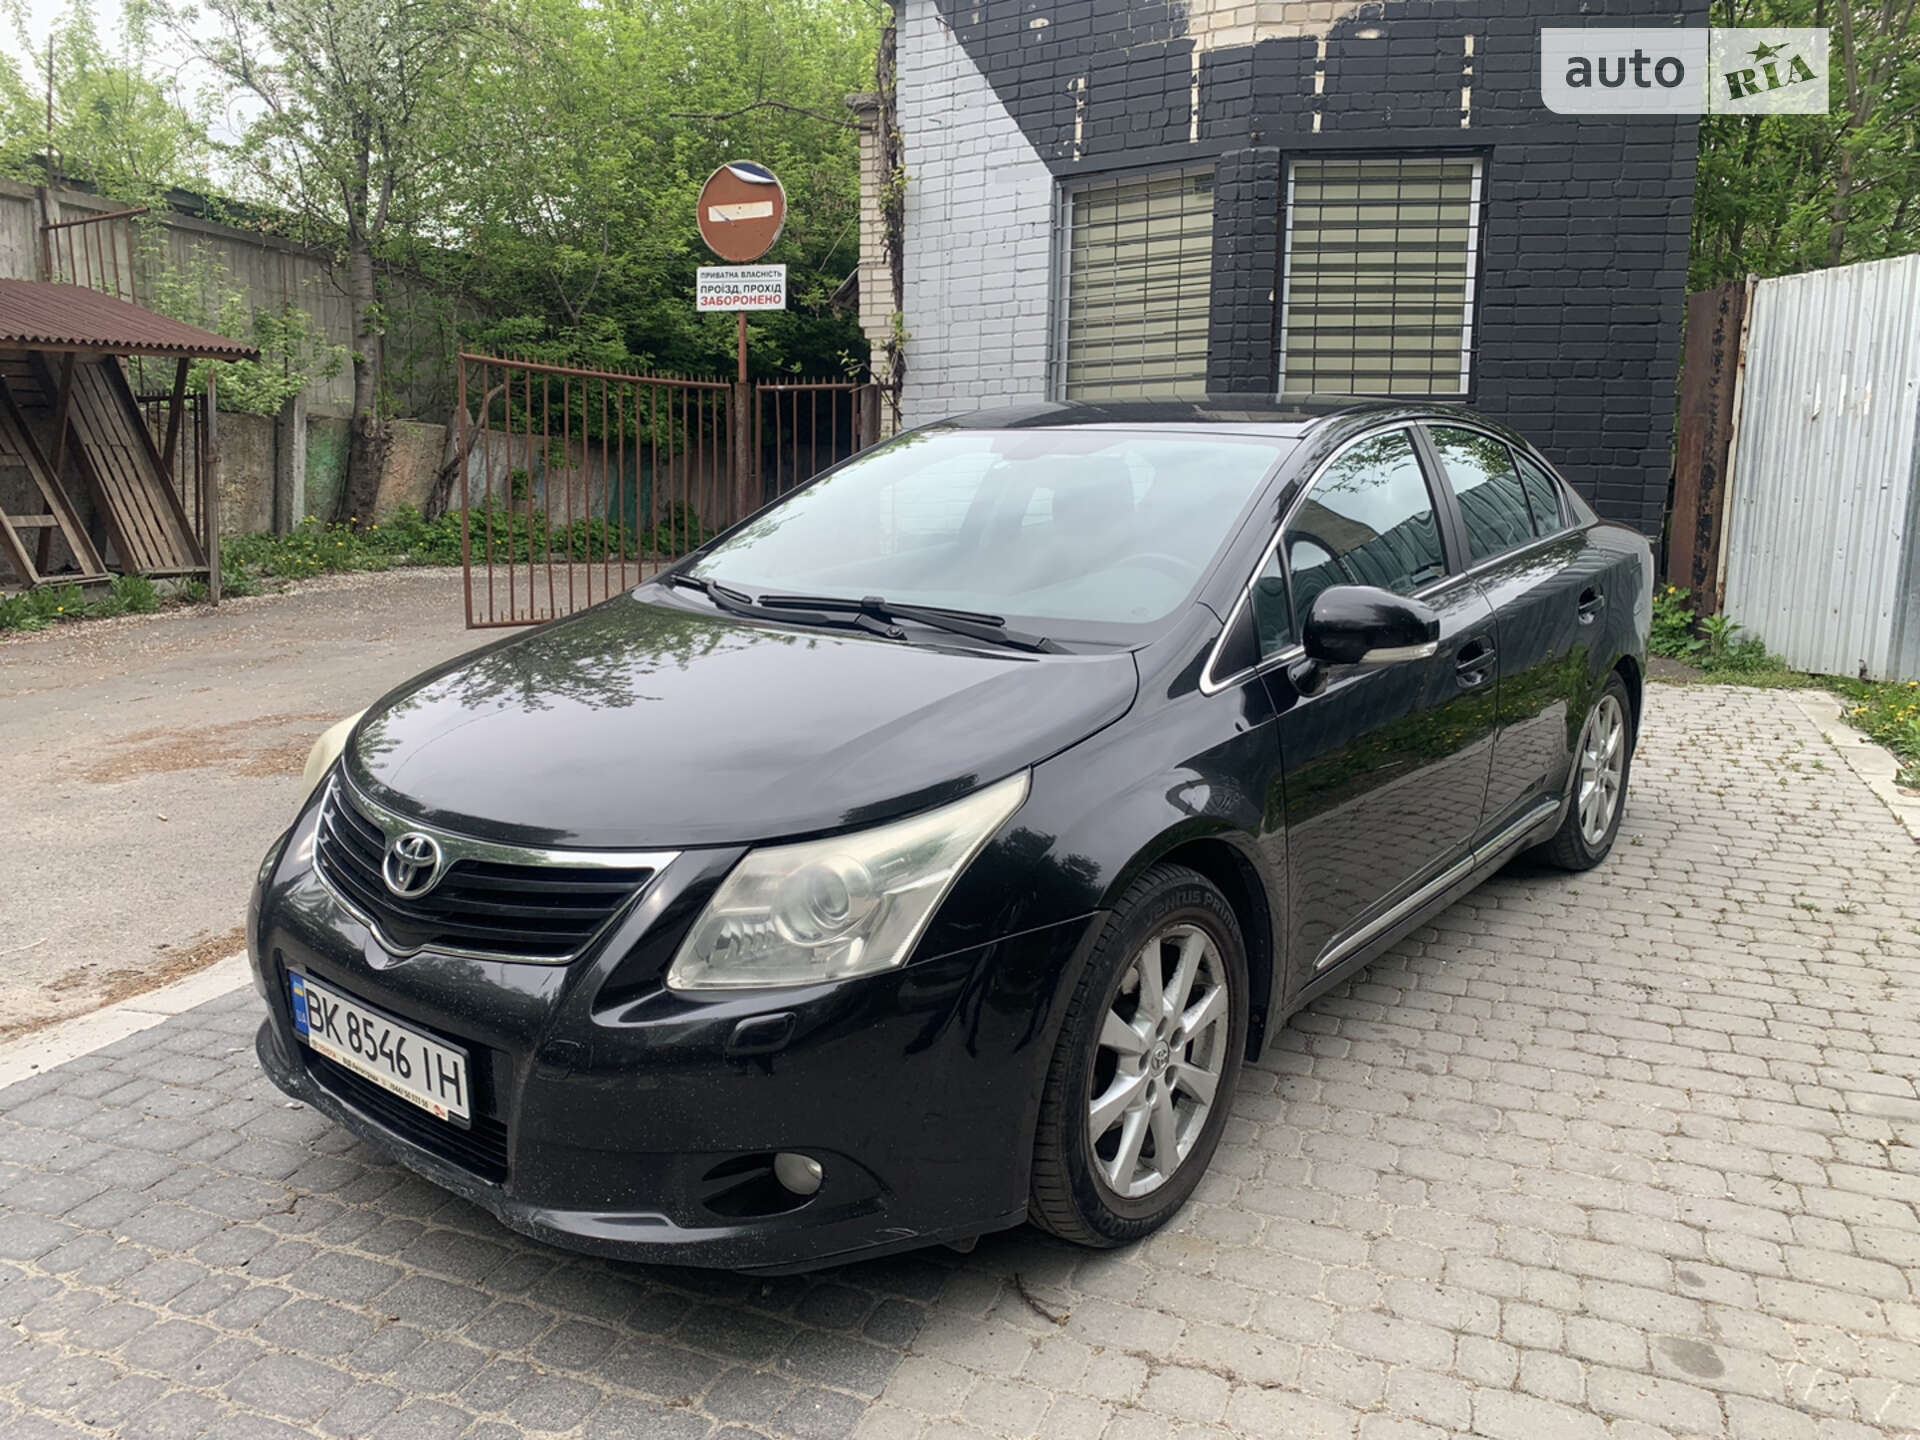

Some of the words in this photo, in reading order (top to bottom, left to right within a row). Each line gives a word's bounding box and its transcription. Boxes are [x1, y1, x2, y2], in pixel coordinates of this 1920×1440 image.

[701, 271, 738, 279] ПРИВАТНА
[741, 270, 783, 279] ВЛАСНІСТЬ
[743, 284, 782, 294] ПРОХІД
[700, 294, 782, 306] ЗАБОРОНЕНО
[305, 988, 343, 1045] BK
[346, 1011, 411, 1079] 8546
[423, 1047, 462, 1107] IH
